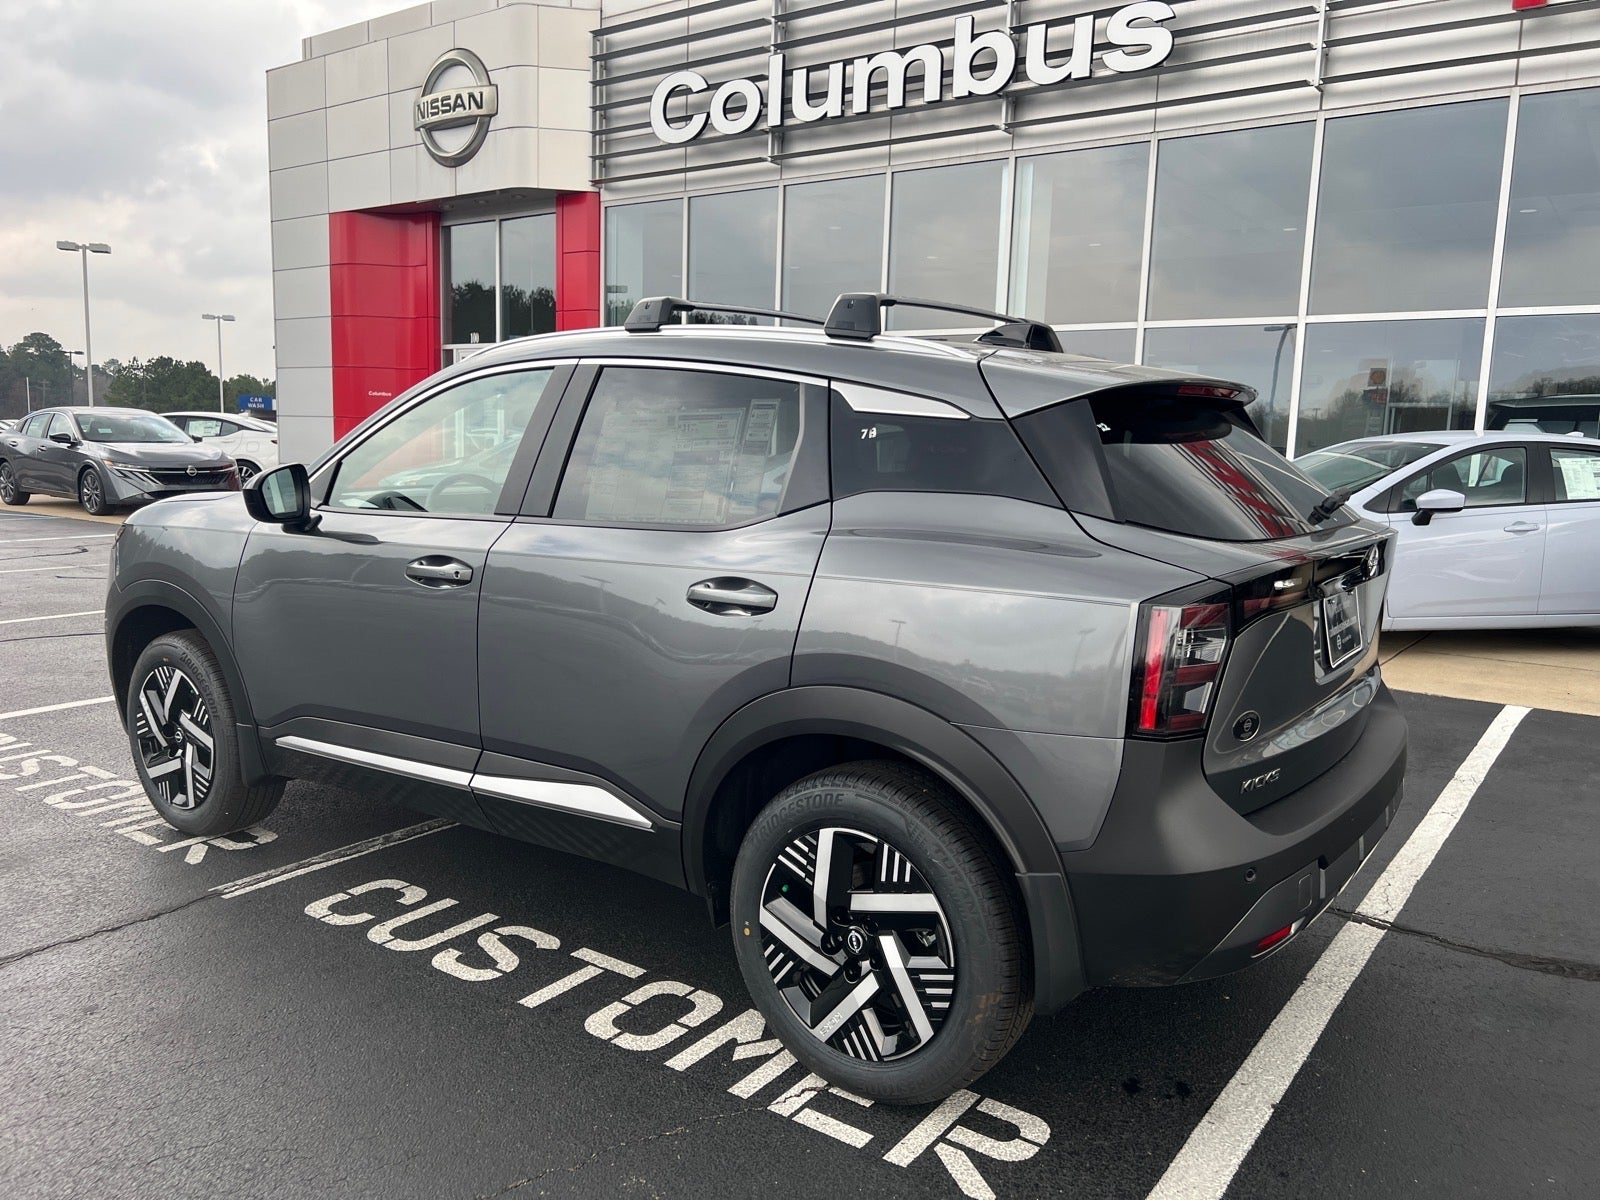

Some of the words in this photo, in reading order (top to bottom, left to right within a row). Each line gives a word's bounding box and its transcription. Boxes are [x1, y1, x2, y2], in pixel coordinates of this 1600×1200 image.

[416, 91, 484, 121] NISSAN
[649, 0, 1177, 145] Columbus
[0, 732, 279, 865] STOMER
[1240, 768, 1281, 794] KICKS
[303, 878, 1051, 1200] CUSTOMER
